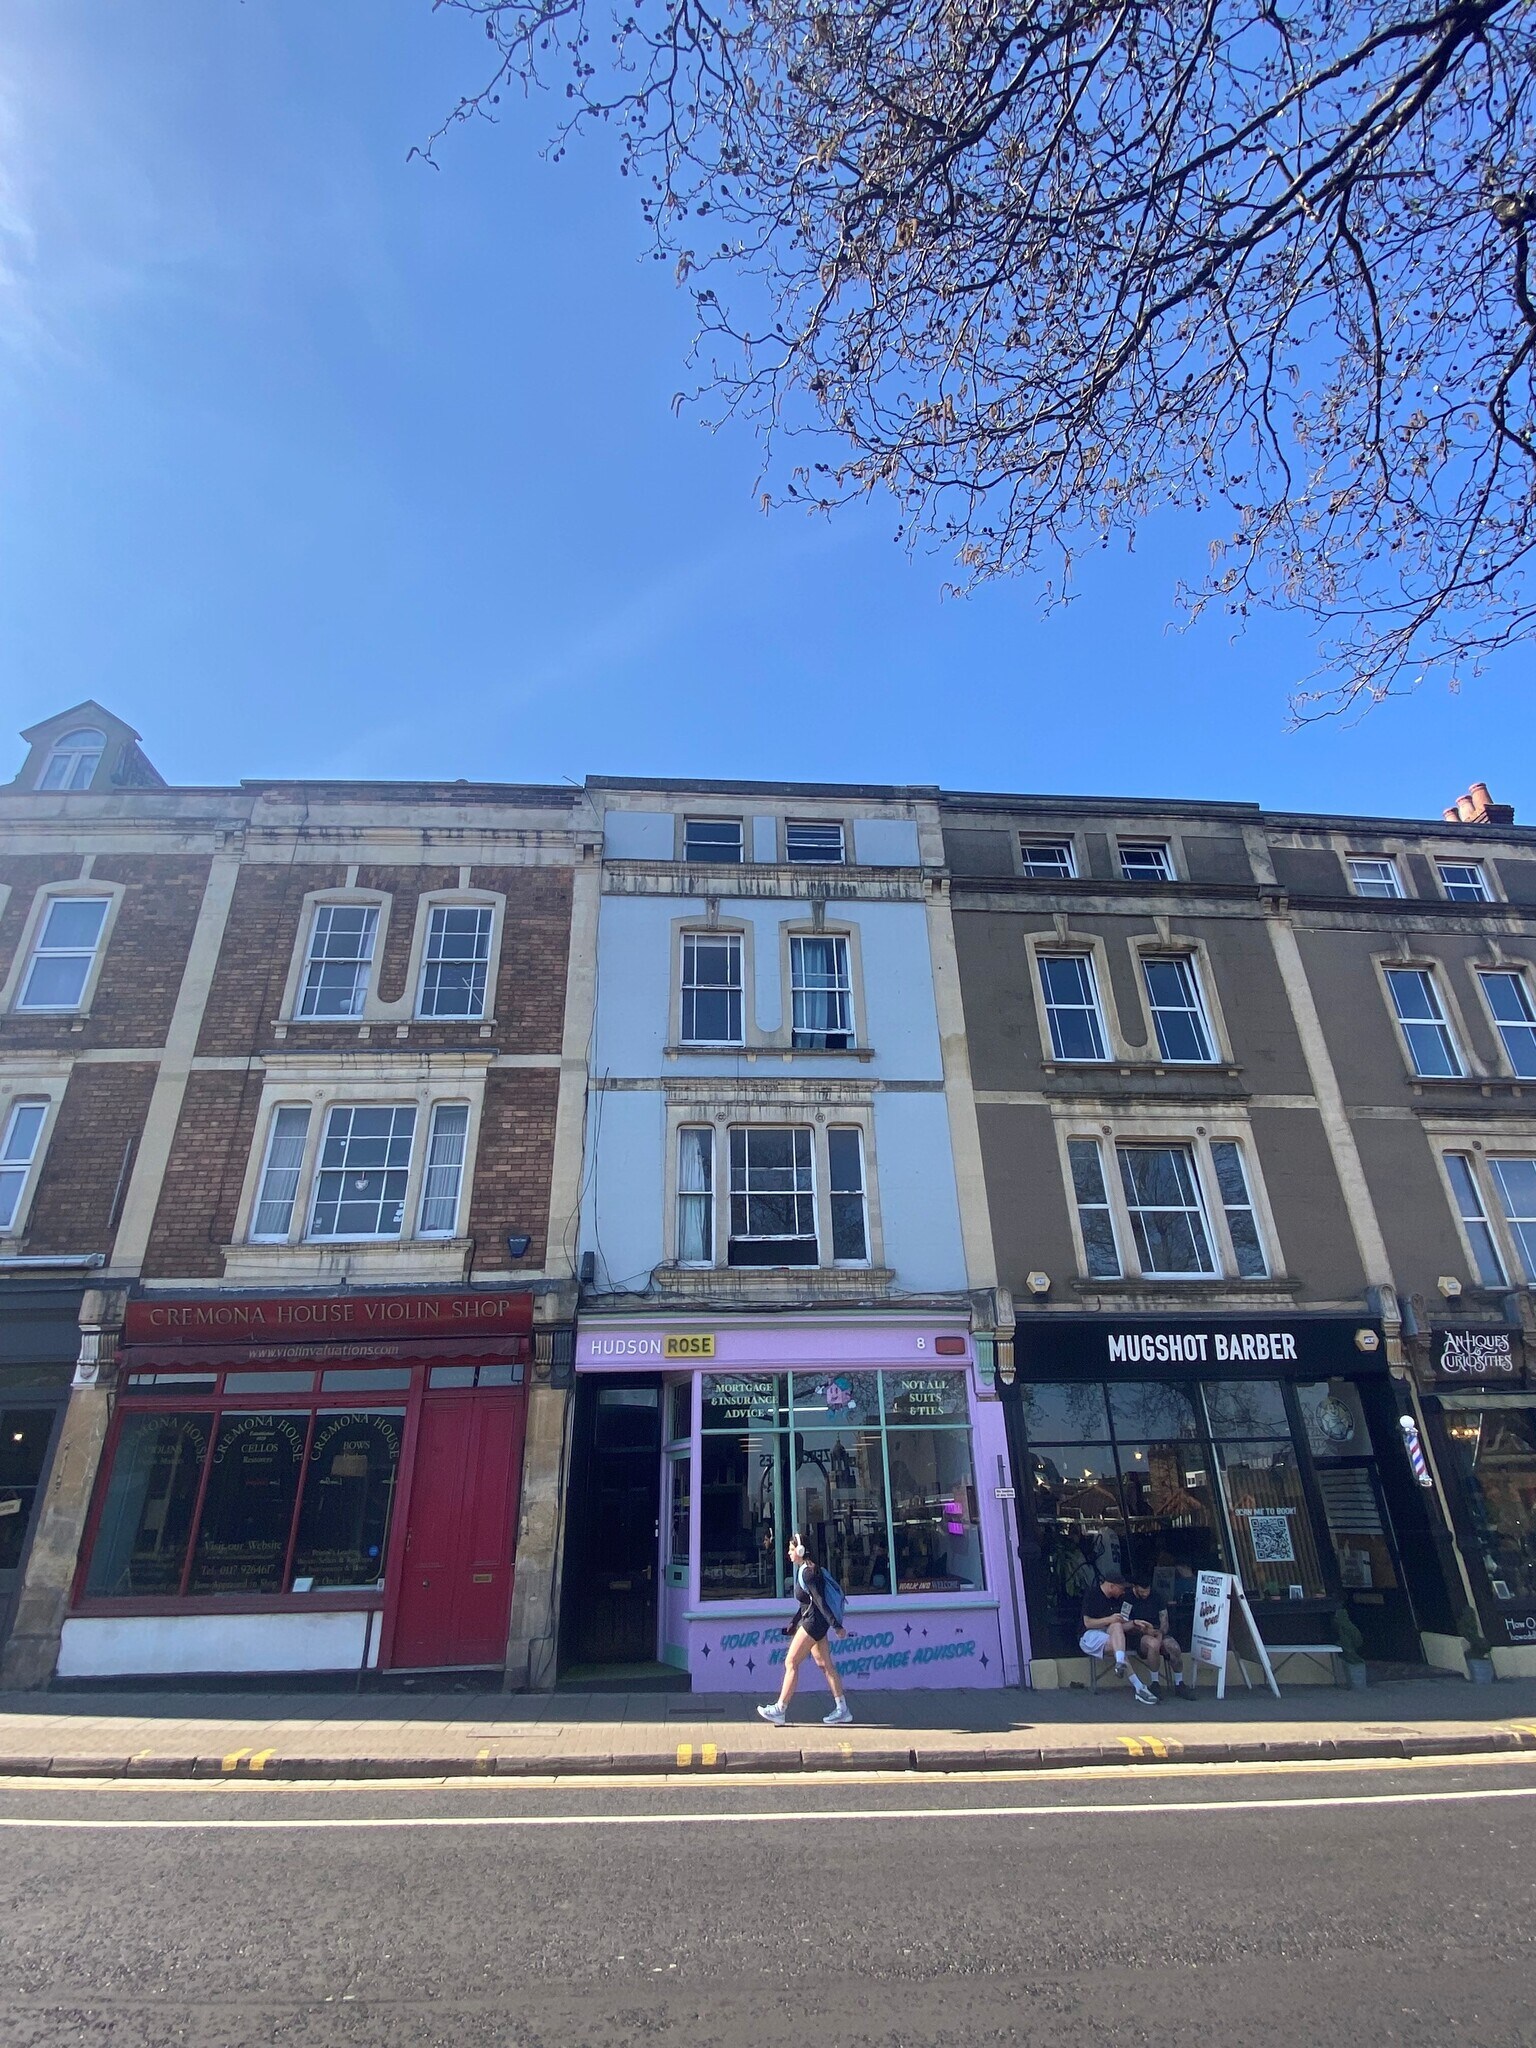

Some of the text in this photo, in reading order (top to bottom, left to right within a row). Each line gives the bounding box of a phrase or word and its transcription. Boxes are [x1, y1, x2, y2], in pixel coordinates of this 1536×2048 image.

[150, 1300, 510, 1326] CREMONA HOUSE VIOLIN SHOP
[591, 1337, 711, 1355] HUDSON ROSE
[916, 1337, 925, 1349] 8
[1108, 1333, 1298, 1362] MUGSHOT BARBER
[1443, 1330, 1510, 1353] ANTIQUES
[249, 1344, 399, 1358] www.violinvaluations.com
[1441, 1351, 1513, 1373] CURIOSITIES
[715, 1383, 773, 1393] MORTGAGE
[901, 1380, 949, 1390] NOT ALL
[909, 1393, 942, 1402] SUITS
[724, 1408, 765, 1418] ADVICE
[213, 1416, 303, 1464] CREMONA HOUSE
[311, 1412, 400, 1461] CREMONA HOUSE
[241, 1443, 279, 1453] CELLOS
[343, 1440, 371, 1450] BOWS
[1201, 1574, 1223, 1586] MUGSHOT
[1202, 1585, 1220, 1597] BARBER
[720, 1630, 760, 1651] YOUR
[835, 1640, 976, 1677] MORTGAGE ADVISOR
